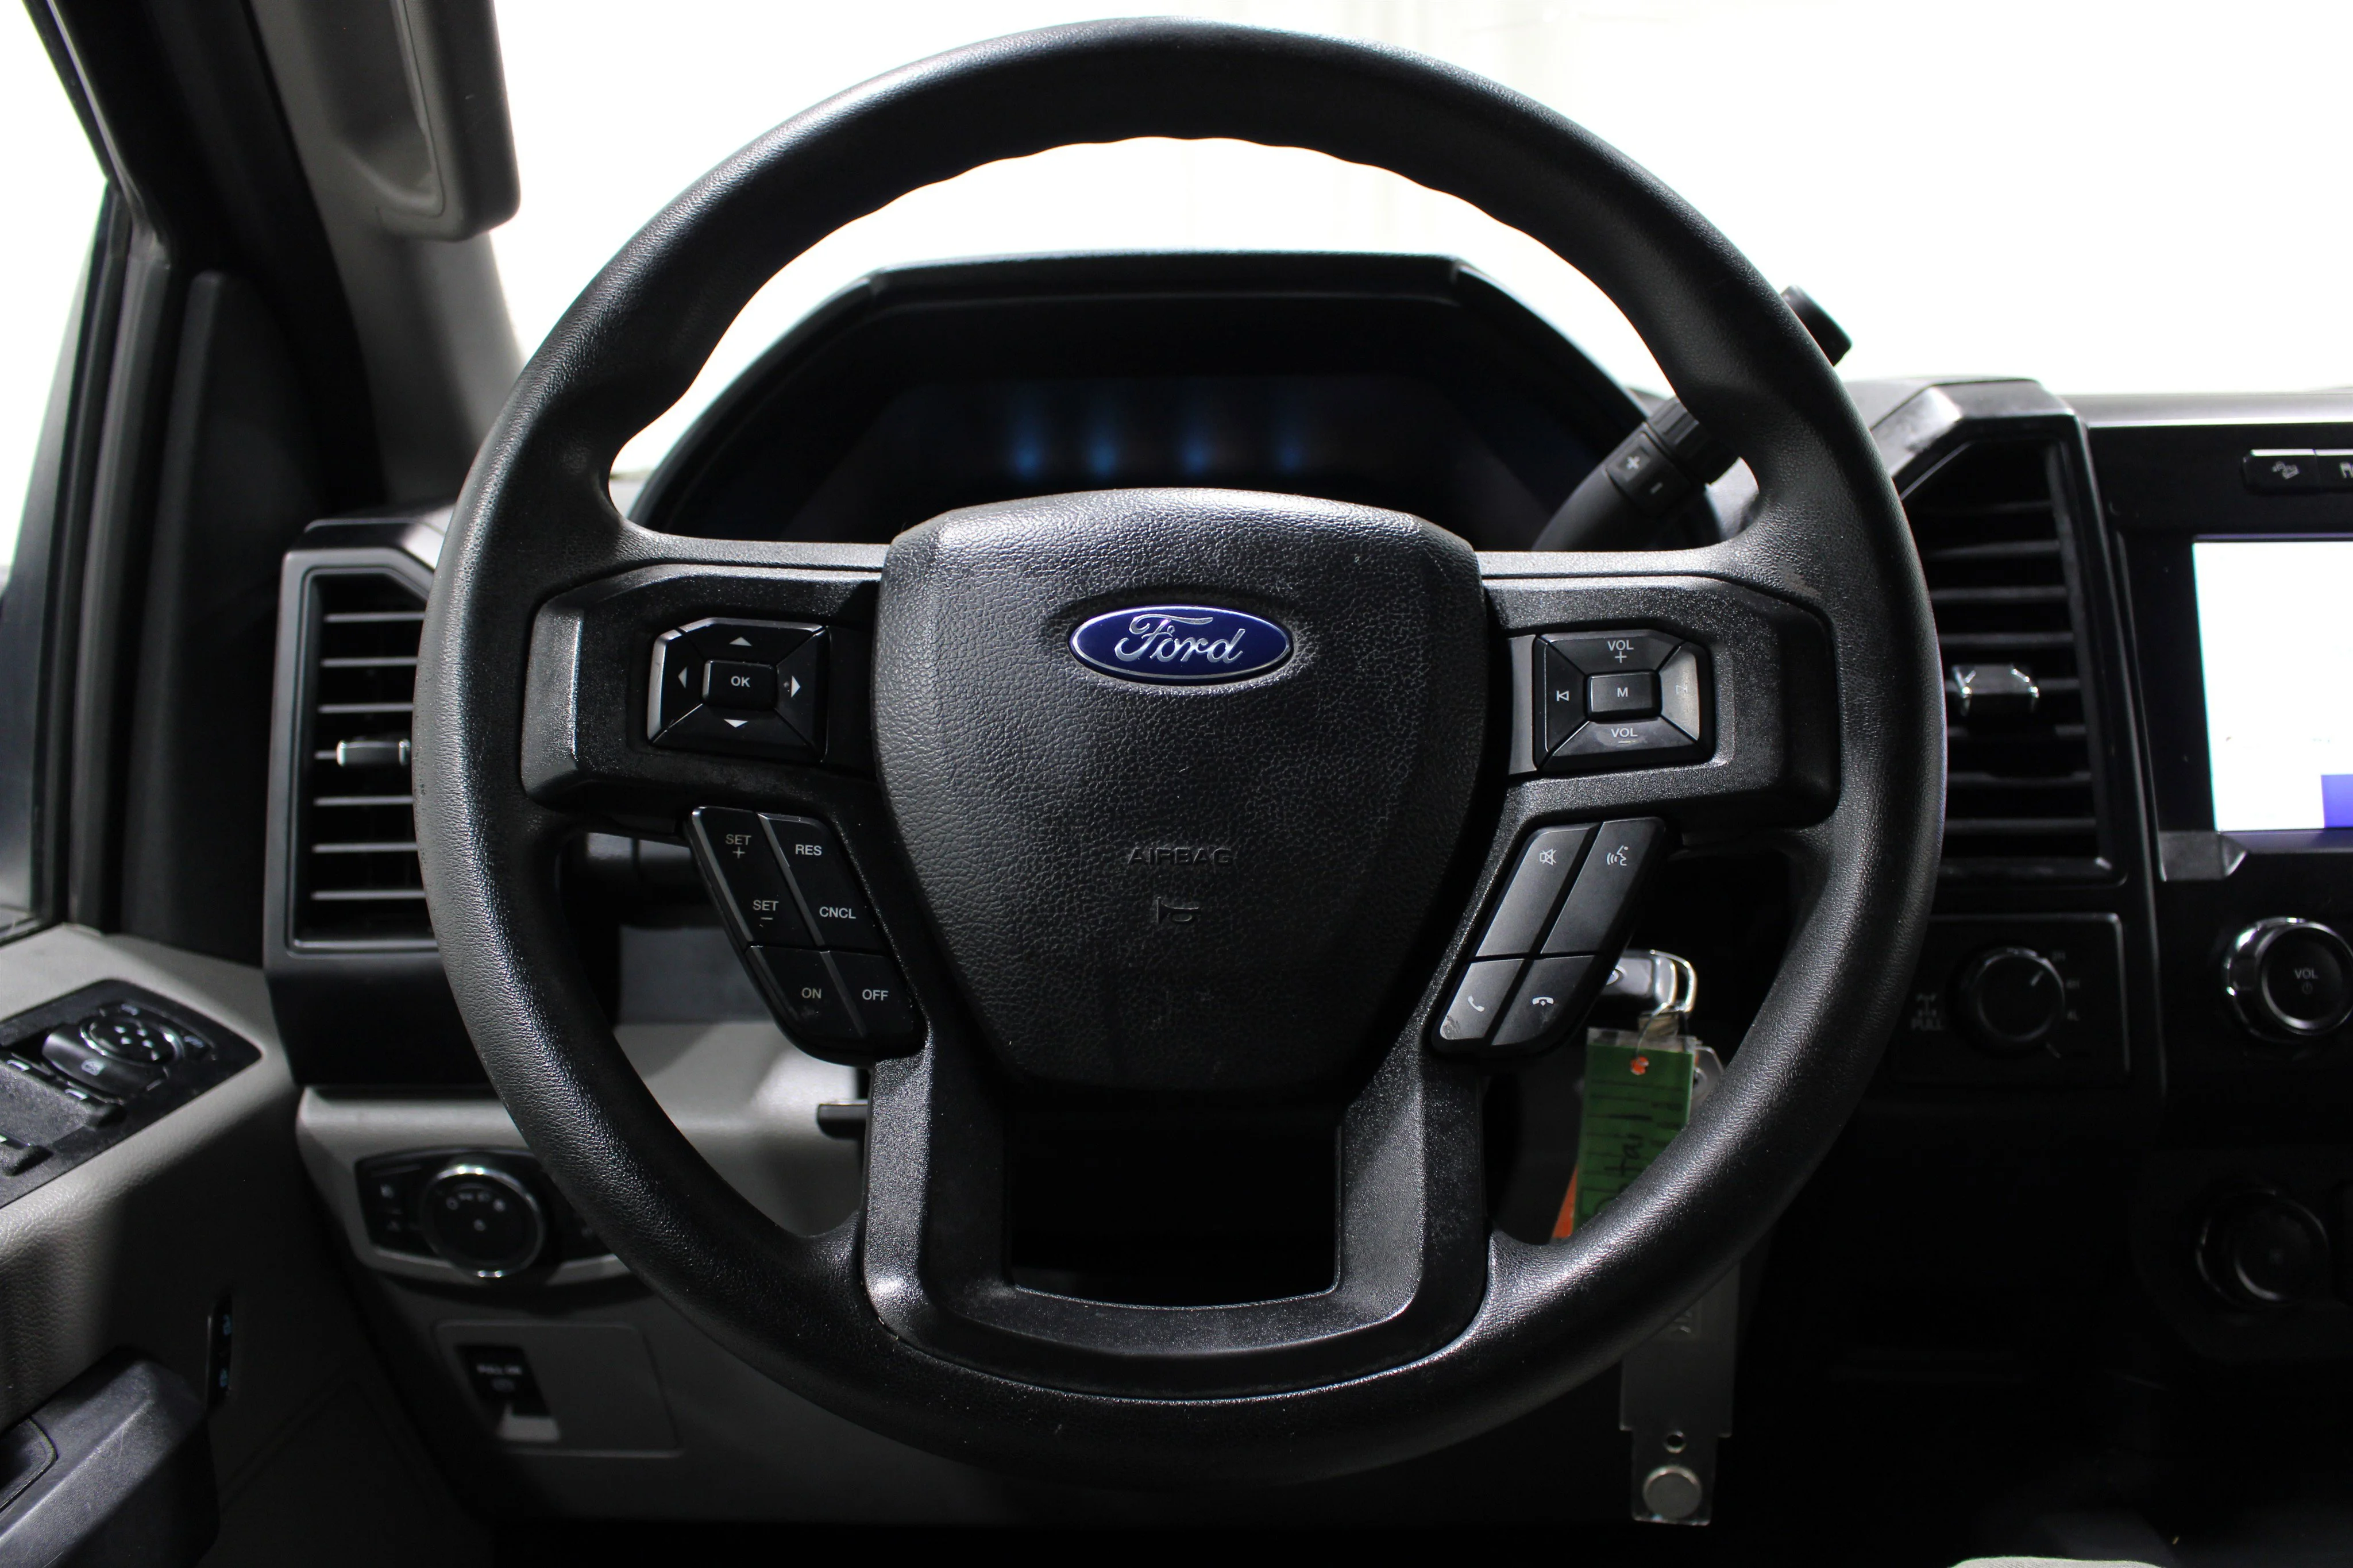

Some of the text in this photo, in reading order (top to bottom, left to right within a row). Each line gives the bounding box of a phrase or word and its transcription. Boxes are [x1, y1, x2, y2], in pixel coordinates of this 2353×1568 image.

[1114, 613, 1246, 664] Ford
[1607, 640, 1634, 651] VOL
[730, 675, 751, 688] OK
[1617, 687, 1629, 697] M
[1611, 728, 1638, 738] VOL
[725, 834, 751, 845] SET
[795, 844, 822, 856] RES
[1127, 847, 1233, 864] AIRBAG
[753, 900, 779, 912] SET
[819, 906, 857, 919] CNCL
[2294, 968, 2317, 979] VOL
[801, 987, 821, 999] ON
[862, 989, 889, 1001] OFF
